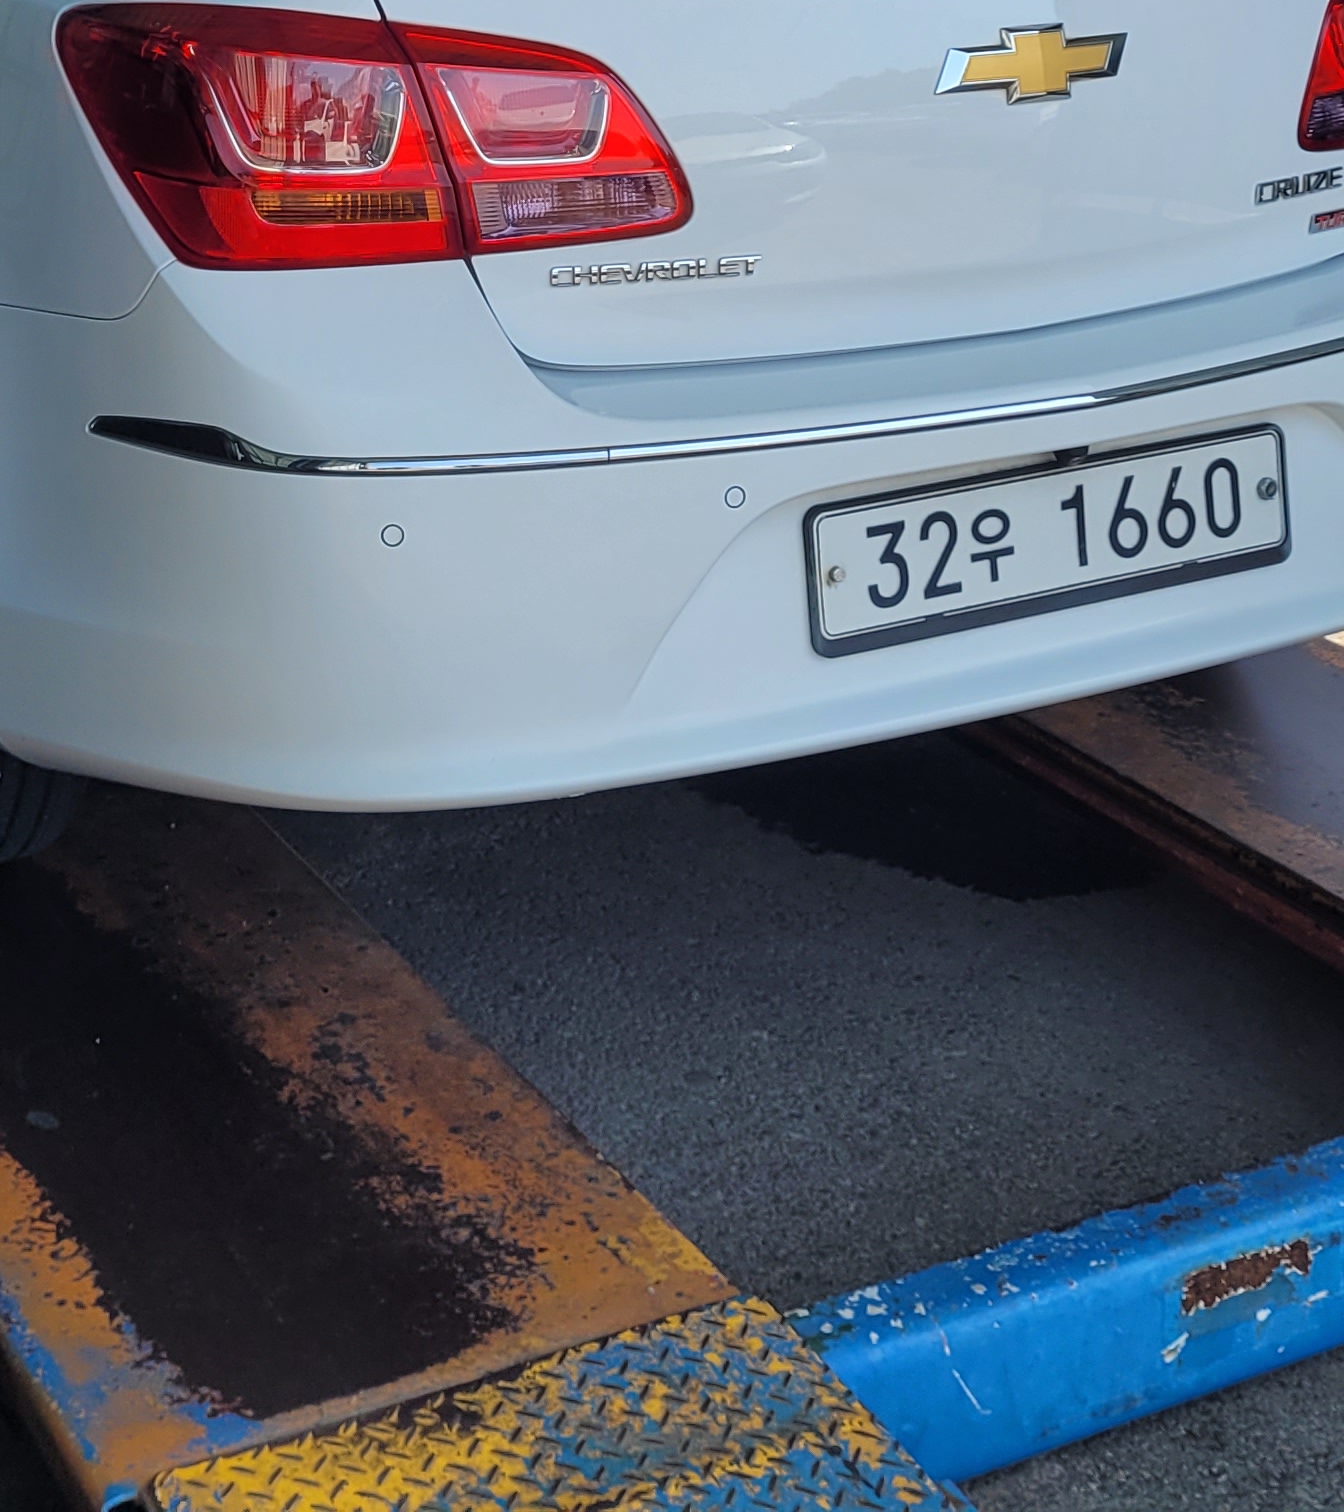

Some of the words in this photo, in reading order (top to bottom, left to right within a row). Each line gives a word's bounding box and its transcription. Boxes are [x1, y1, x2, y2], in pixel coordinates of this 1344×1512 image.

[1254, 166, 1344, 206] CRUZE
[549, 254, 764, 288] CHEVROLET
[865, 508, 1015, 609] 32우
[1060, 457, 1242, 567] 1660
